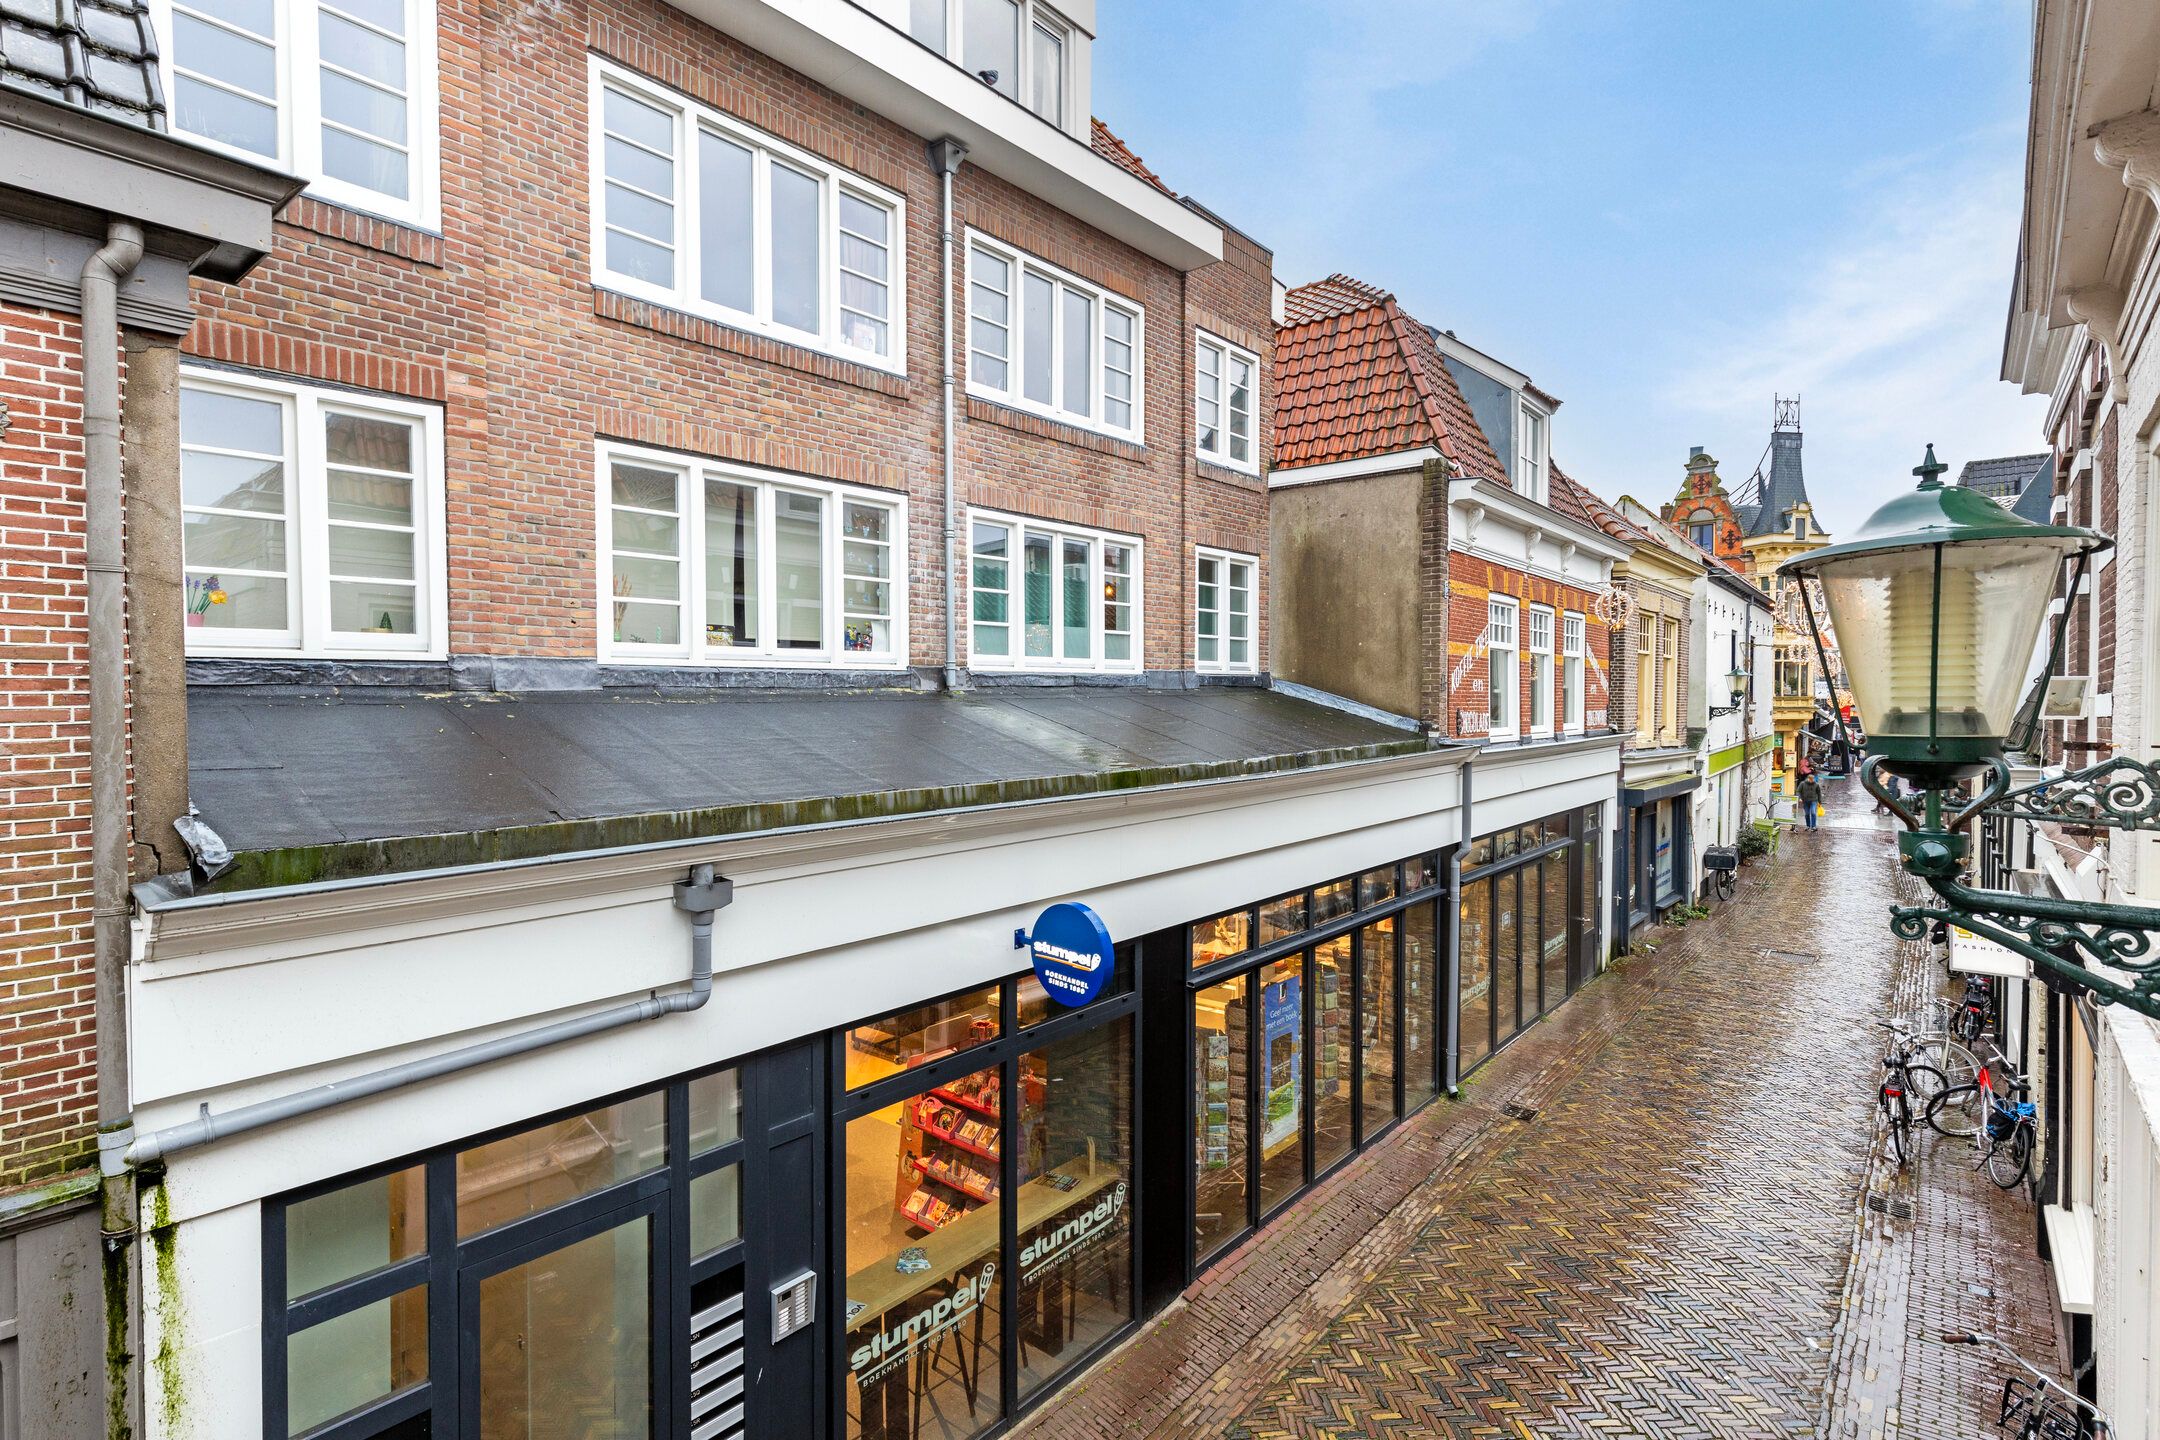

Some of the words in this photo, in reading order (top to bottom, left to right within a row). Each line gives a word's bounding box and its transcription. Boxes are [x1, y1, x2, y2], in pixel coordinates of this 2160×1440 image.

[1473, 679, 1484, 691] en
[1034, 942, 1091, 966] stumpel
[1954, 943, 2013, 954] FASHION
[1045, 970, 1088, 989] BOEKHANDEL
[1048, 977, 1068, 989] SINDS
[1020, 1194, 1113, 1267] stumpel
[1028, 1253, 1071, 1282] BOEKHANDEL
[851, 1276, 977, 1371] stumpel
[863, 1350, 920, 1388] BOEKHANDEL
[923, 1331, 947, 1351] SINDS
